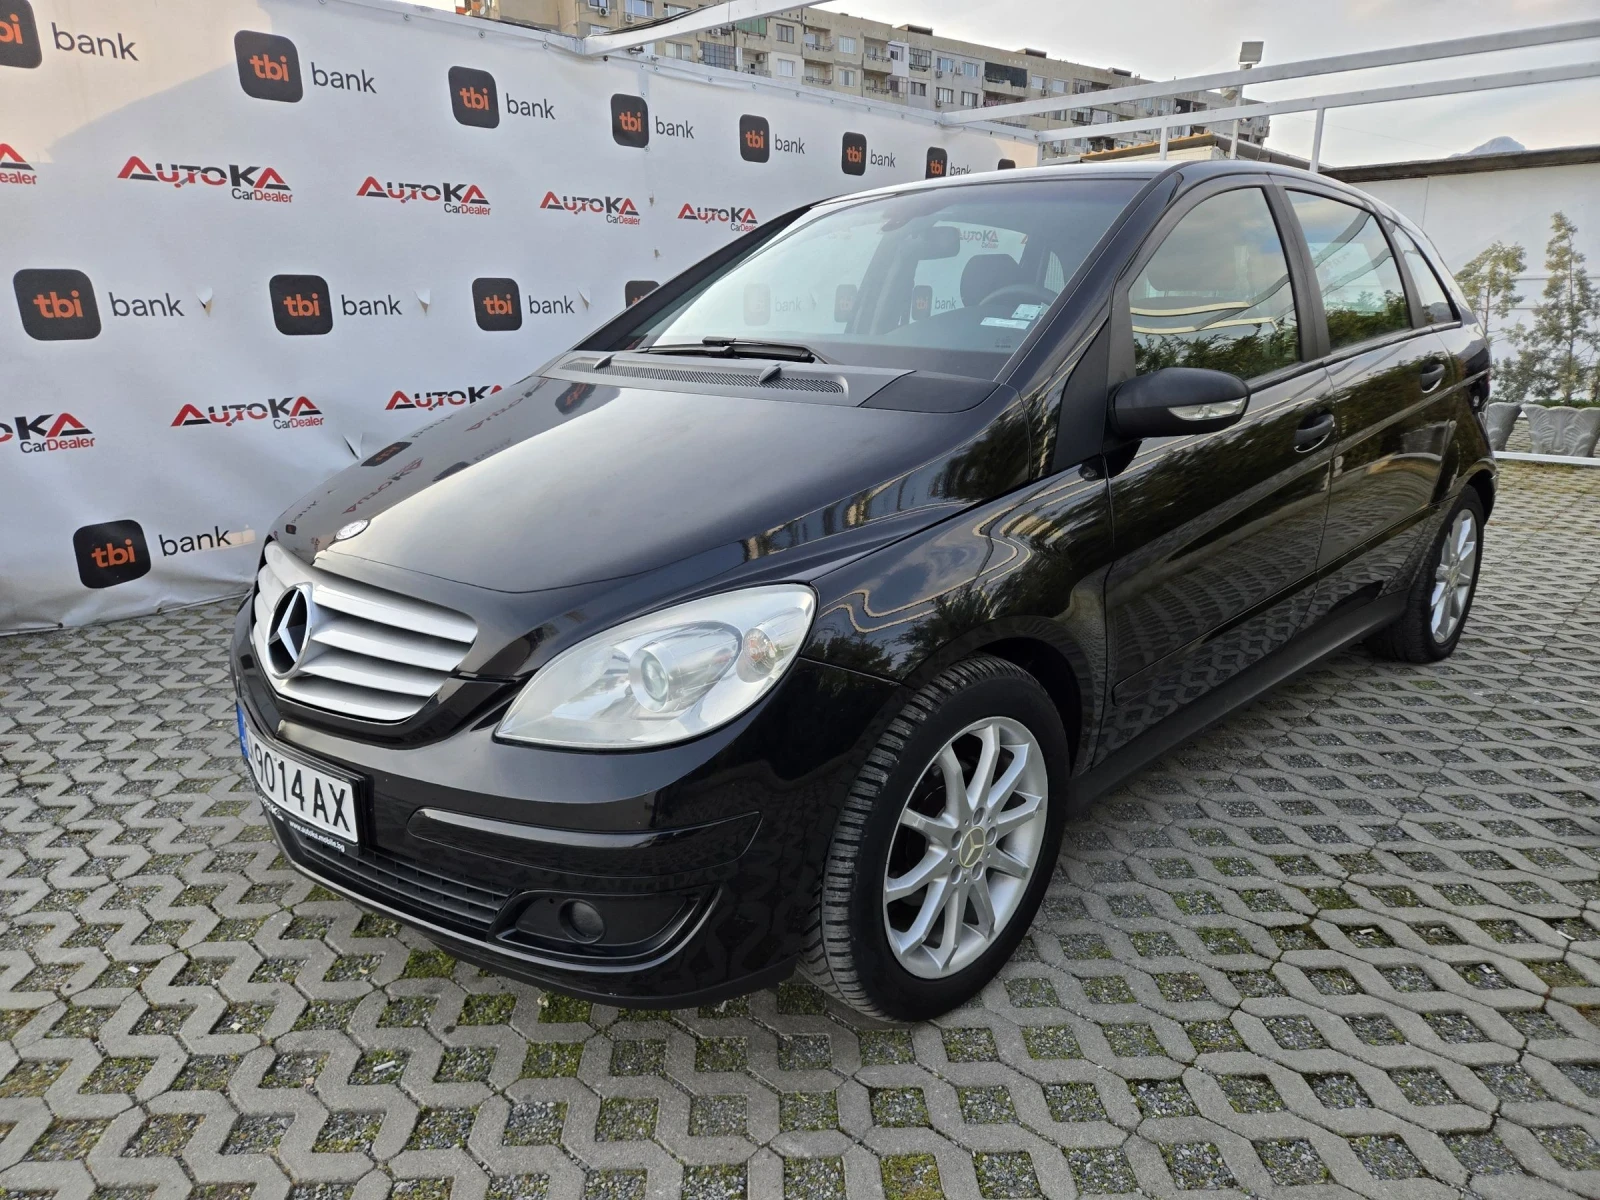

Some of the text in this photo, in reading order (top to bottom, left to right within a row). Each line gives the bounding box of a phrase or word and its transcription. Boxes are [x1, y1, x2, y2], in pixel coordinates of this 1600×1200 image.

[51, 22, 139, 62] bank
[249, 55, 377, 94] tbi bank
[460, 87, 556, 120] tbi bank
[619, 111, 695, 139] tbi bank
[745, 130, 806, 155] tbi bank
[846, 145, 896, 168] tbi bank
[930, 160, 943, 175] tbi
[0, 171, 37, 185] ealer
[231, 188, 293, 203] CarDealer
[443, 203, 491, 216] CarDealer
[33, 291, 185, 319] tbi bank
[283, 293, 403, 317] tbi bank
[483, 293, 575, 315] tbi bank
[935, 296, 957, 310] bank
[385, 385, 502, 411] AUTOK
[273, 416, 325, 430] CarDealer
[20, 437, 95, 454] CarDealer
[91, 526, 233, 568] tbi bank
[254, 742, 304, 812] 9014
[313, 777, 351, 833] AX
